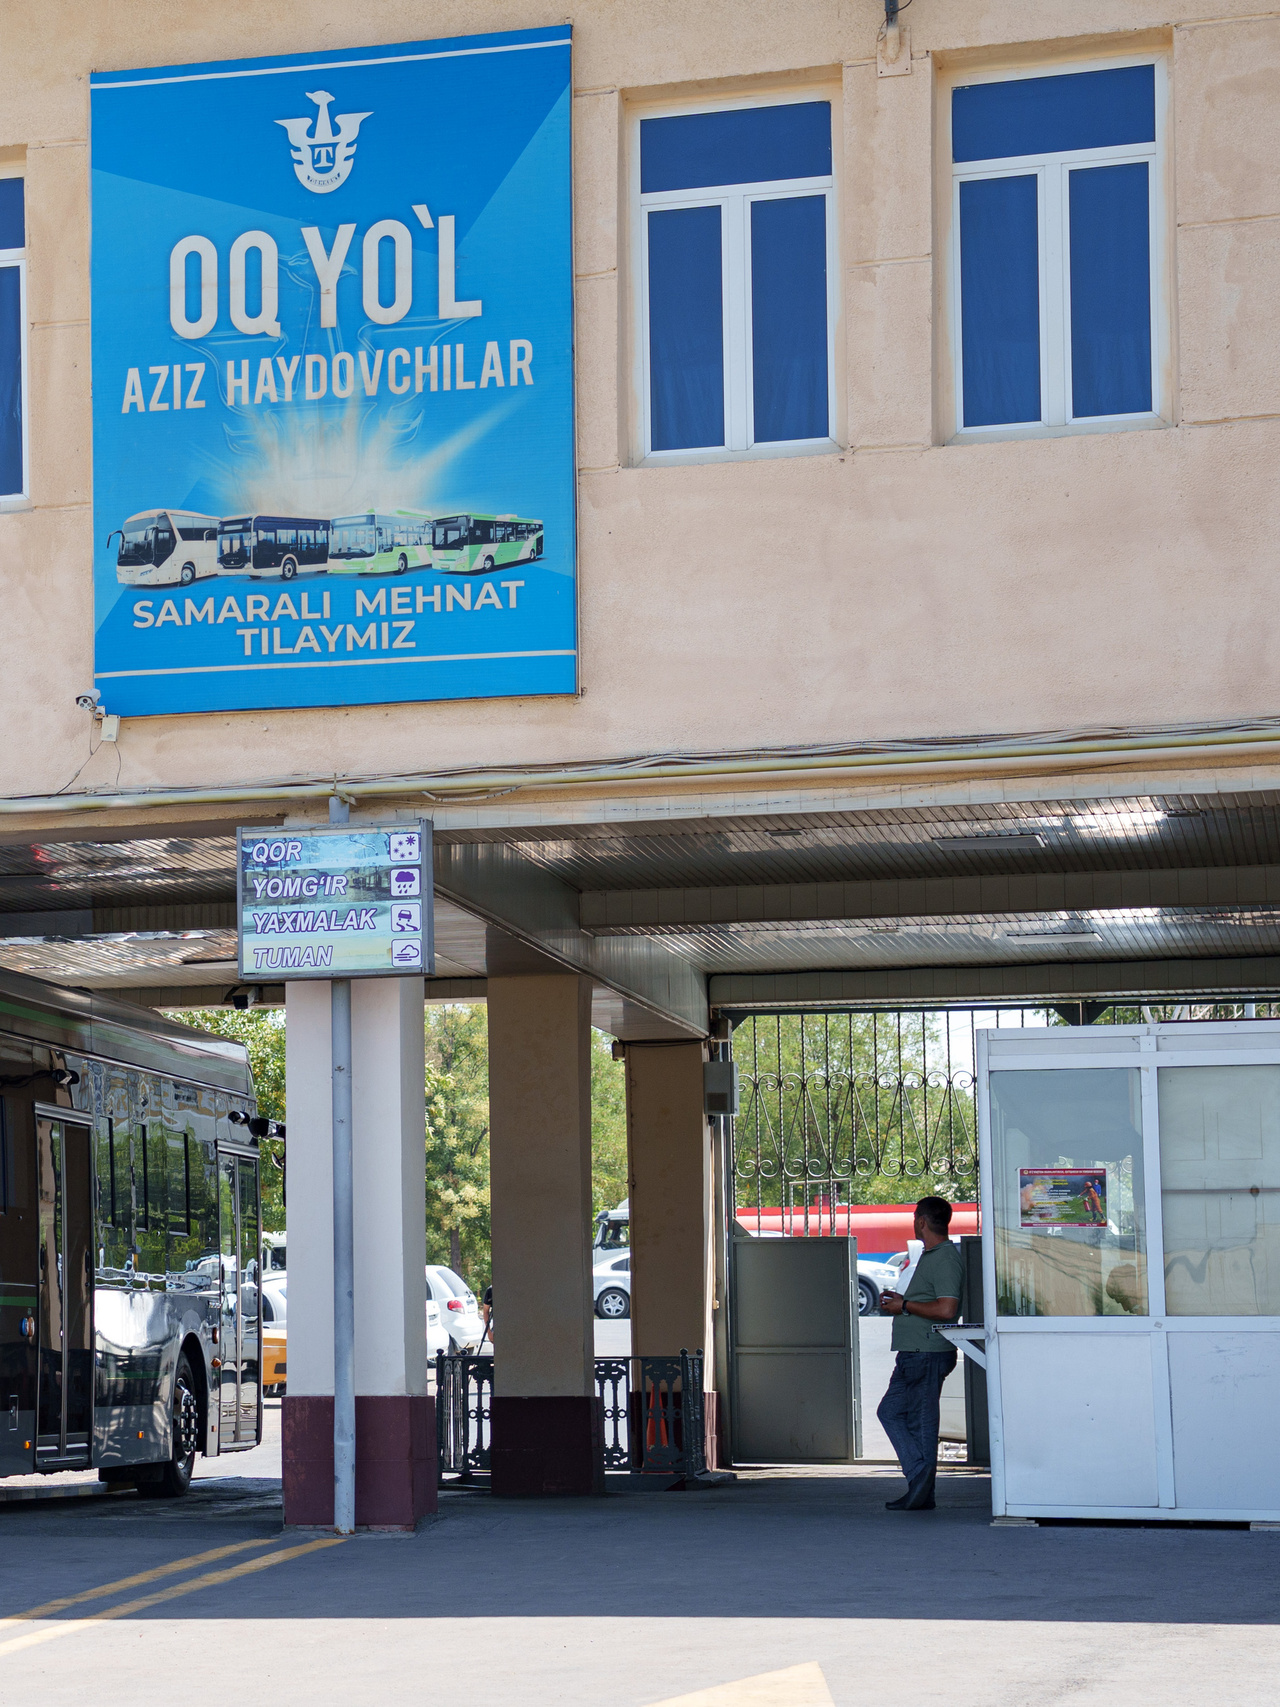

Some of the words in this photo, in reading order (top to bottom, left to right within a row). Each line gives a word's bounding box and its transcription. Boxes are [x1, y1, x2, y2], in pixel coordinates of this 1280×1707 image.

[169, 229, 282, 341] OQ
[121, 361, 207, 415] AZIZ
[226, 339, 535, 407] HAYDOVCHILAR
[132, 591, 332, 630] SAMARALI
[355, 580, 526, 618] MEHNAT
[236, 620, 417, 657] TILAYMIZ
[252, 840, 302, 864] QOR
[253, 908, 377, 934] YAXMALAK
[253, 945, 333, 969] TUMAN
